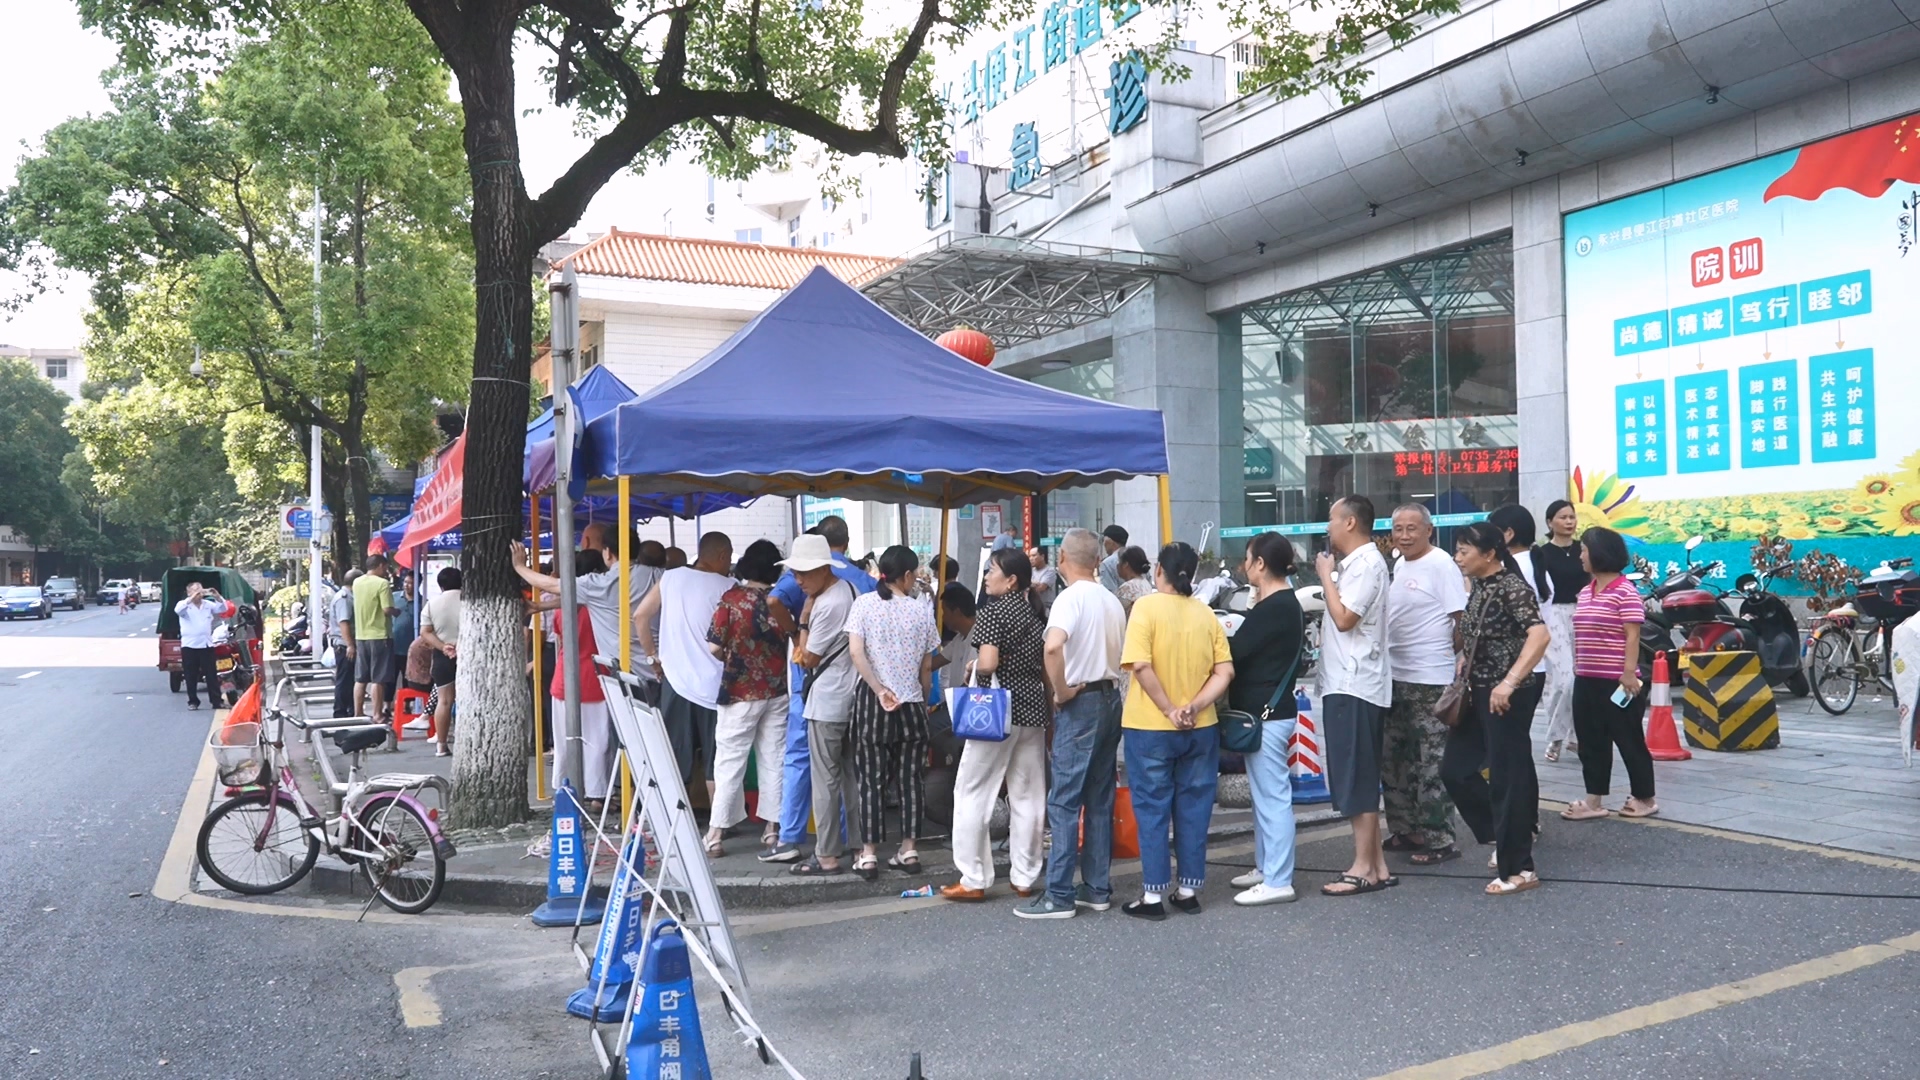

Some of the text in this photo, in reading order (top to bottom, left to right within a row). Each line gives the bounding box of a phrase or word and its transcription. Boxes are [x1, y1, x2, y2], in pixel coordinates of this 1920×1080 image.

[1694, 243, 1759, 284] 院训
[1619, 282, 1863, 347] 尚德 精诚 笃行 睦邻
[1623, 397, 1638, 464] 崇尚医德
[1643, 395, 1657, 462] 以德为先
[1684, 388, 1700, 459] 医术精湛
[1705, 386, 1720, 456] 态度真诚
[1749, 379, 1766, 453] 脚踏实地
[1772, 376, 1788, 450] 践行医道
[1820, 370, 1838, 448] 共生共融
[1845, 366, 1864, 446] 呵护健康
[1395, 460, 1517, 476] 第一社区卫生服务中
[433, 533, 462, 546] 永兴
[557, 837, 576, 894] 日丰管
